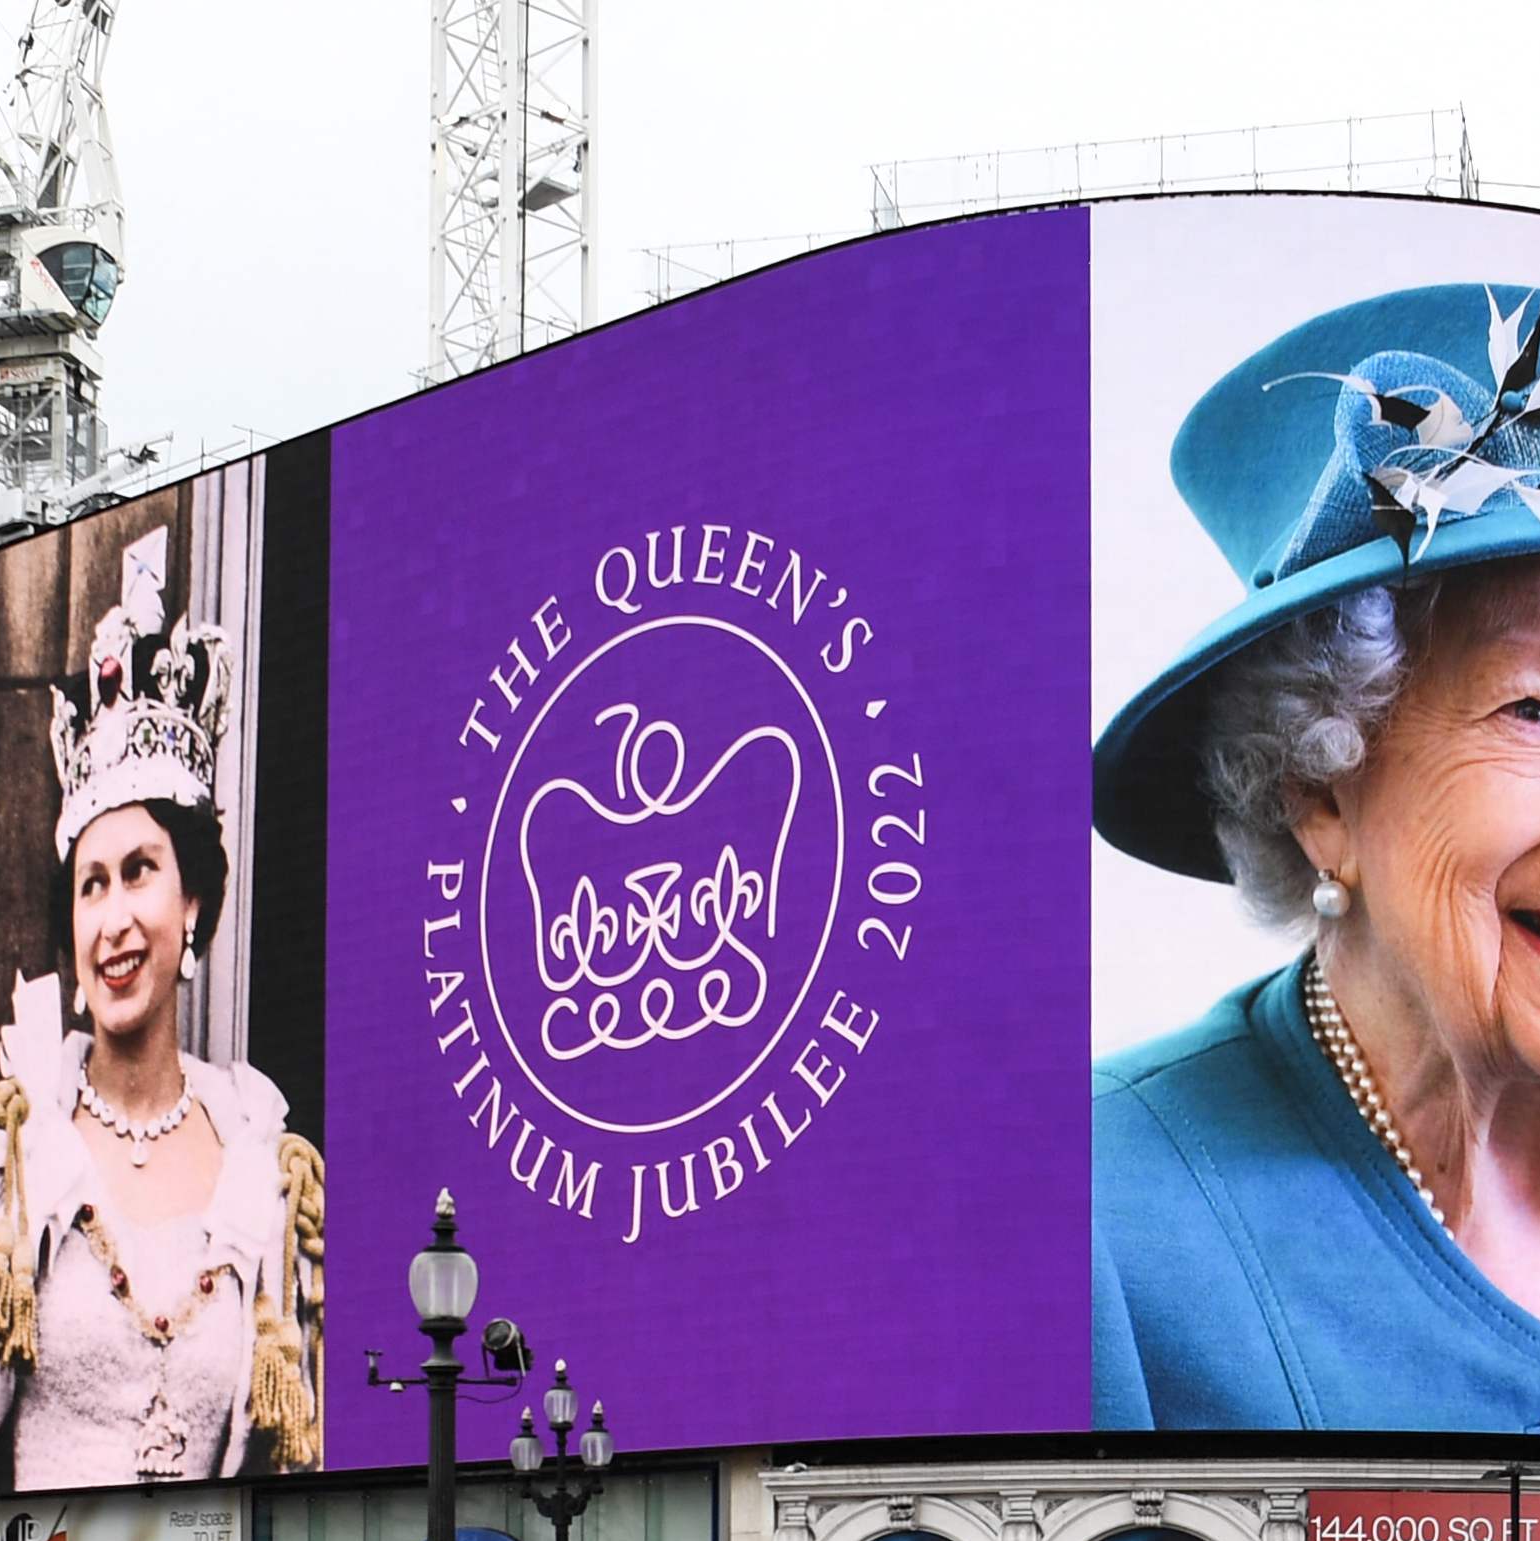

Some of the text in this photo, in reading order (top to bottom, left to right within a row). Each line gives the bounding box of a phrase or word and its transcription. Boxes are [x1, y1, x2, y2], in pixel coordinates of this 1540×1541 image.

[459, 525, 873, 752] THE QUEEN'S
[424, 753, 925, 1243] PLATINUM JUBILEE 2022
[170, 1512, 232, 1527] Retail space
